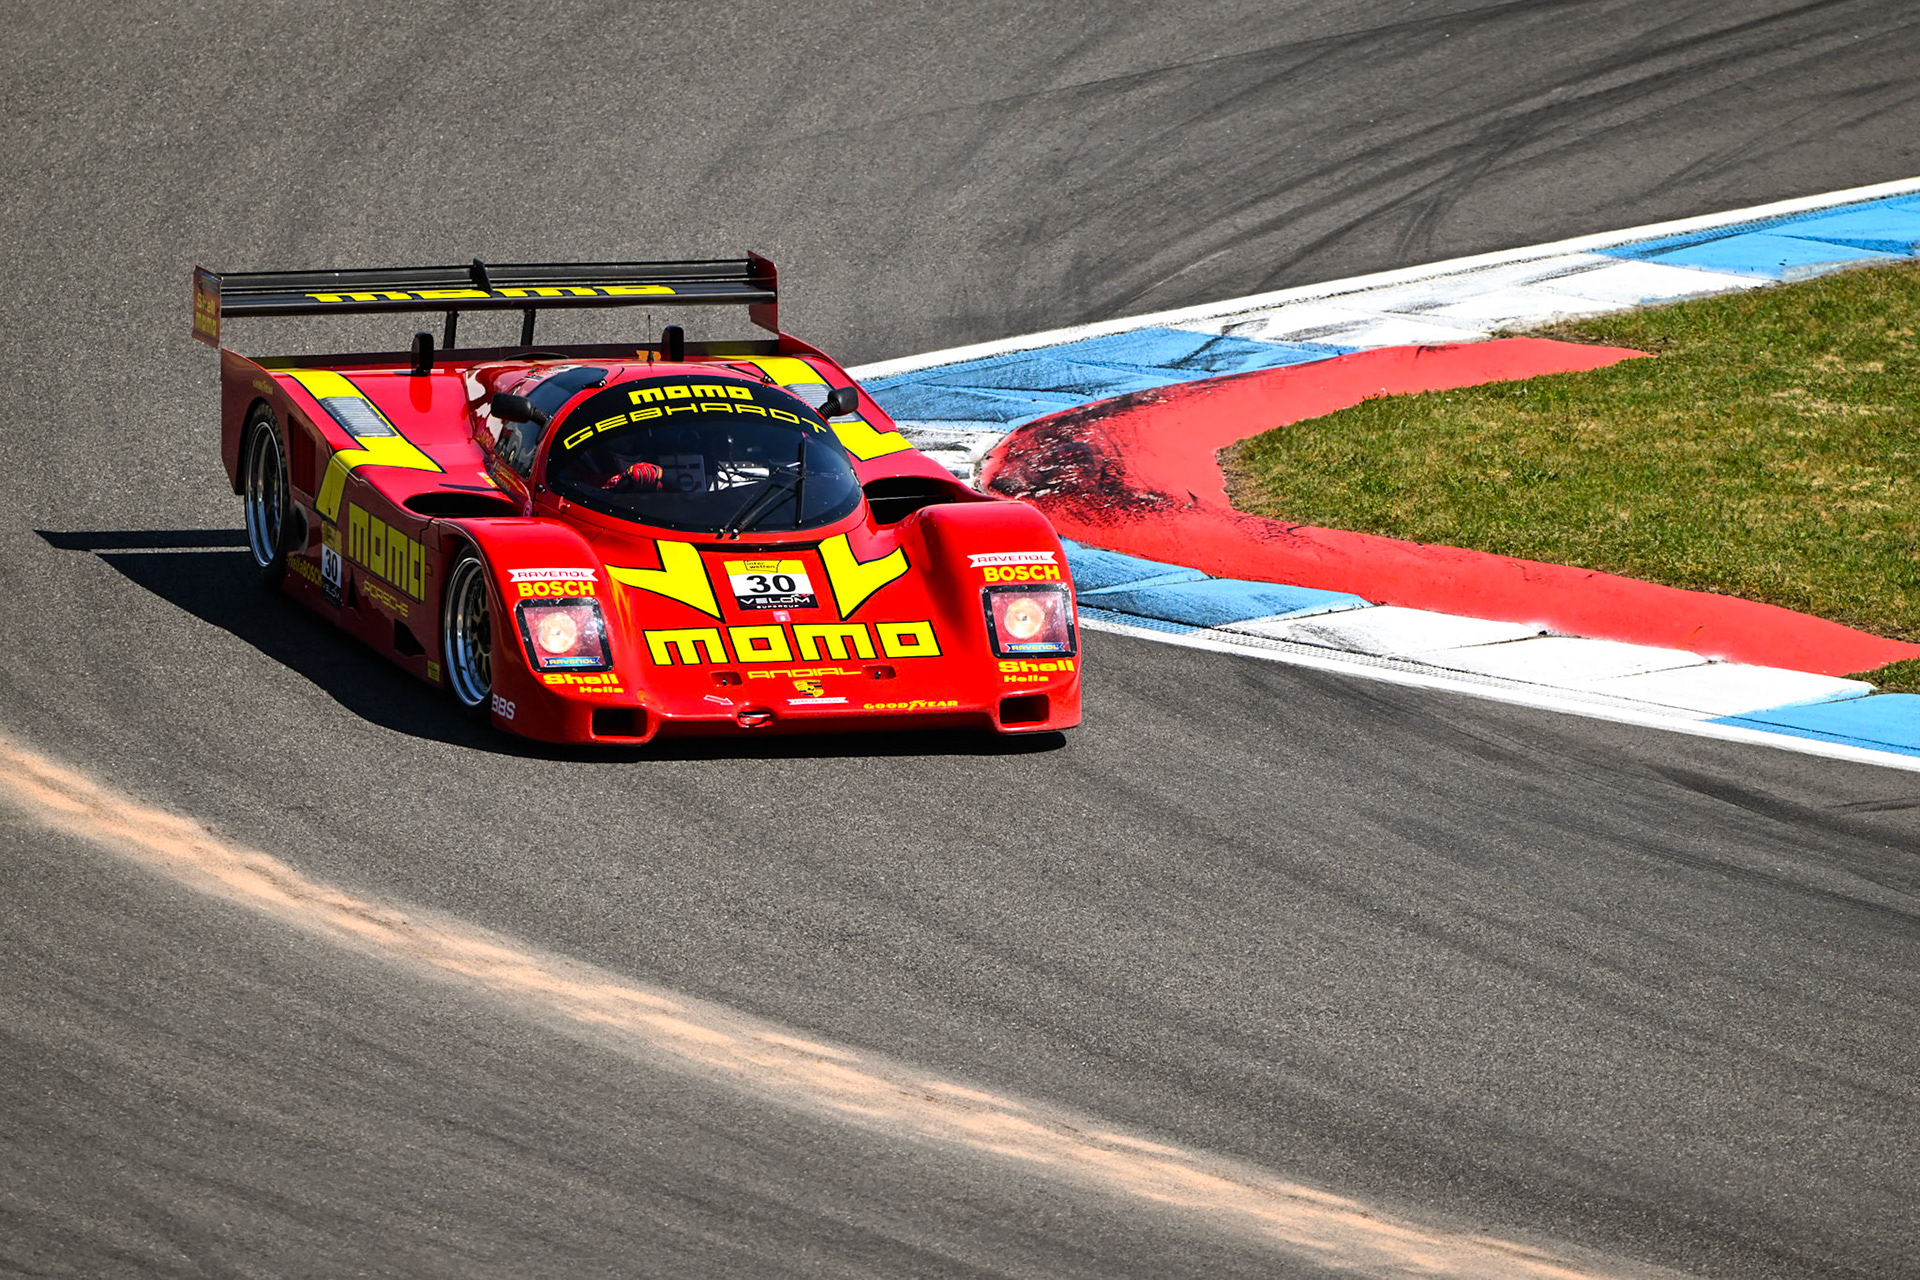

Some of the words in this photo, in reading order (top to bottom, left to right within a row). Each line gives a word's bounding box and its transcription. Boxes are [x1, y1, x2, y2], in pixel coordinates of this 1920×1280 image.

[563, 402, 827, 450] GEBHARDT
[977, 554, 1049, 563] RAVENOL
[325, 549, 338, 583] 30
[517, 570, 590, 578] RAVENOL
[983, 565, 1061, 582] BOSCH
[517, 581, 595, 597] BOSCH
[746, 574, 796, 593] 30
[363, 580, 409, 618] PORSCHE
[740, 596, 811, 605] VELOM
[747, 668, 862, 679] ANDIAL
[998, 660, 1075, 673] Shell
[543, 673, 619, 685] Shell
[491, 694, 516, 720] BBS
[863, 700, 959, 711] GOODYEAR
